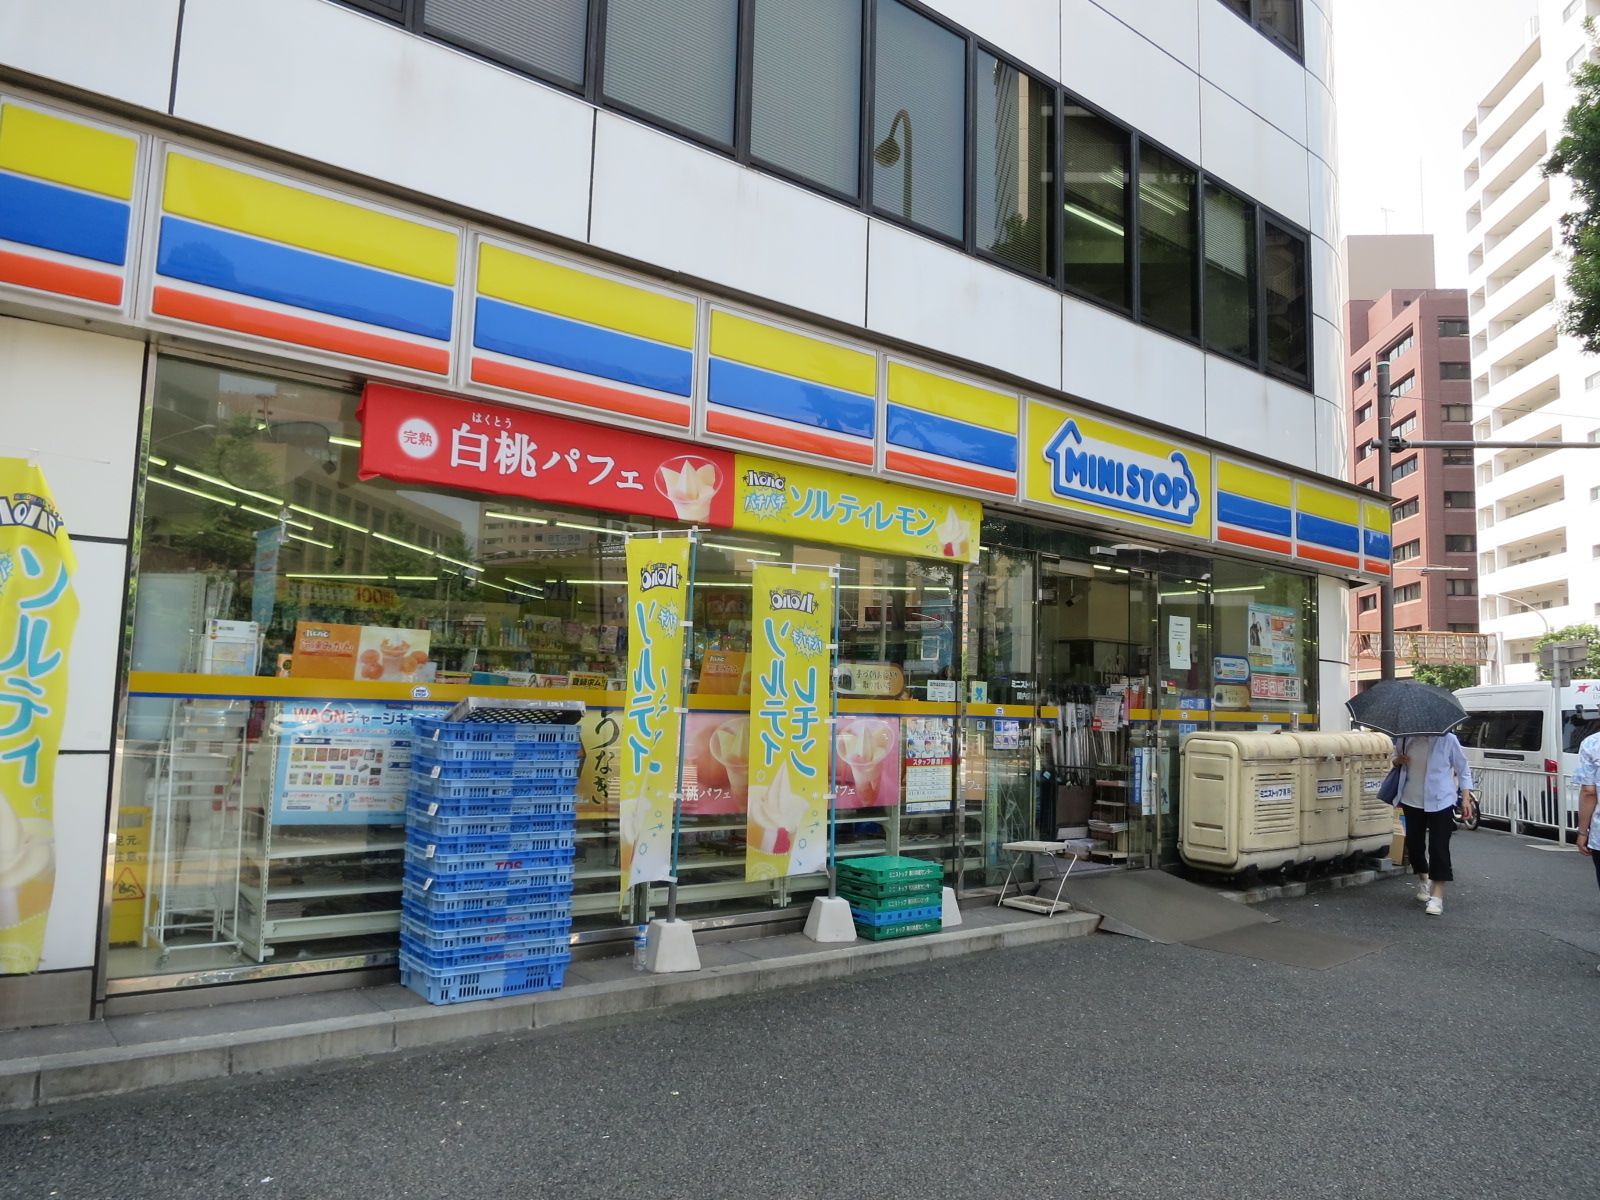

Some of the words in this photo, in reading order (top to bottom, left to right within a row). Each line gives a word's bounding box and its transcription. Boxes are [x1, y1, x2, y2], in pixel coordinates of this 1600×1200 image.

[403, 429, 433, 448] 完熟
[471, 412, 513, 429] はくとう
[450, 422, 644, 491] 白桃パフェ
[1065, 447, 1188, 510] MINISTOP
[789, 485, 937, 537] ソルティレモン
